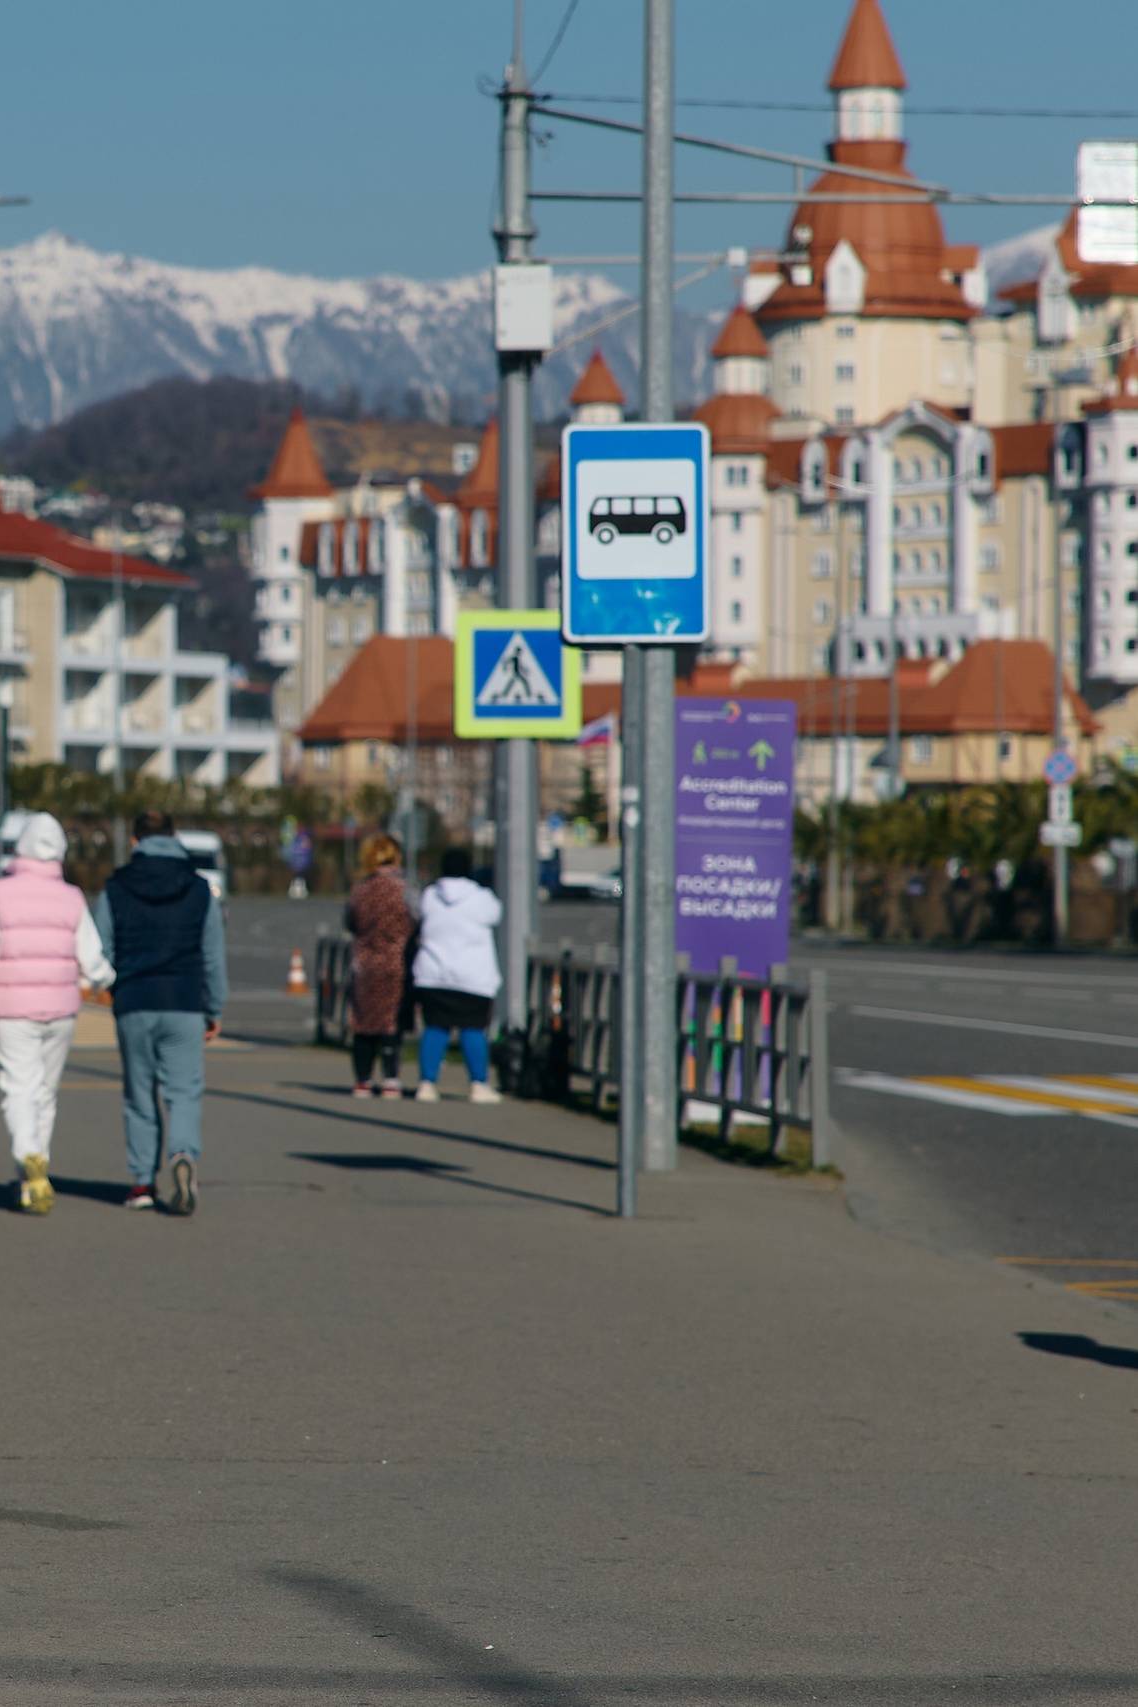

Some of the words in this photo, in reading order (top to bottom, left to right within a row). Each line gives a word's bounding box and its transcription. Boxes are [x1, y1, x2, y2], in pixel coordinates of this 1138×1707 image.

[680, 776, 787, 795] Accreditation
[705, 794, 759, 811] Center
[702, 854, 757, 873] ЗОНА
[679, 897, 778, 920] ВЫСАДКИ
